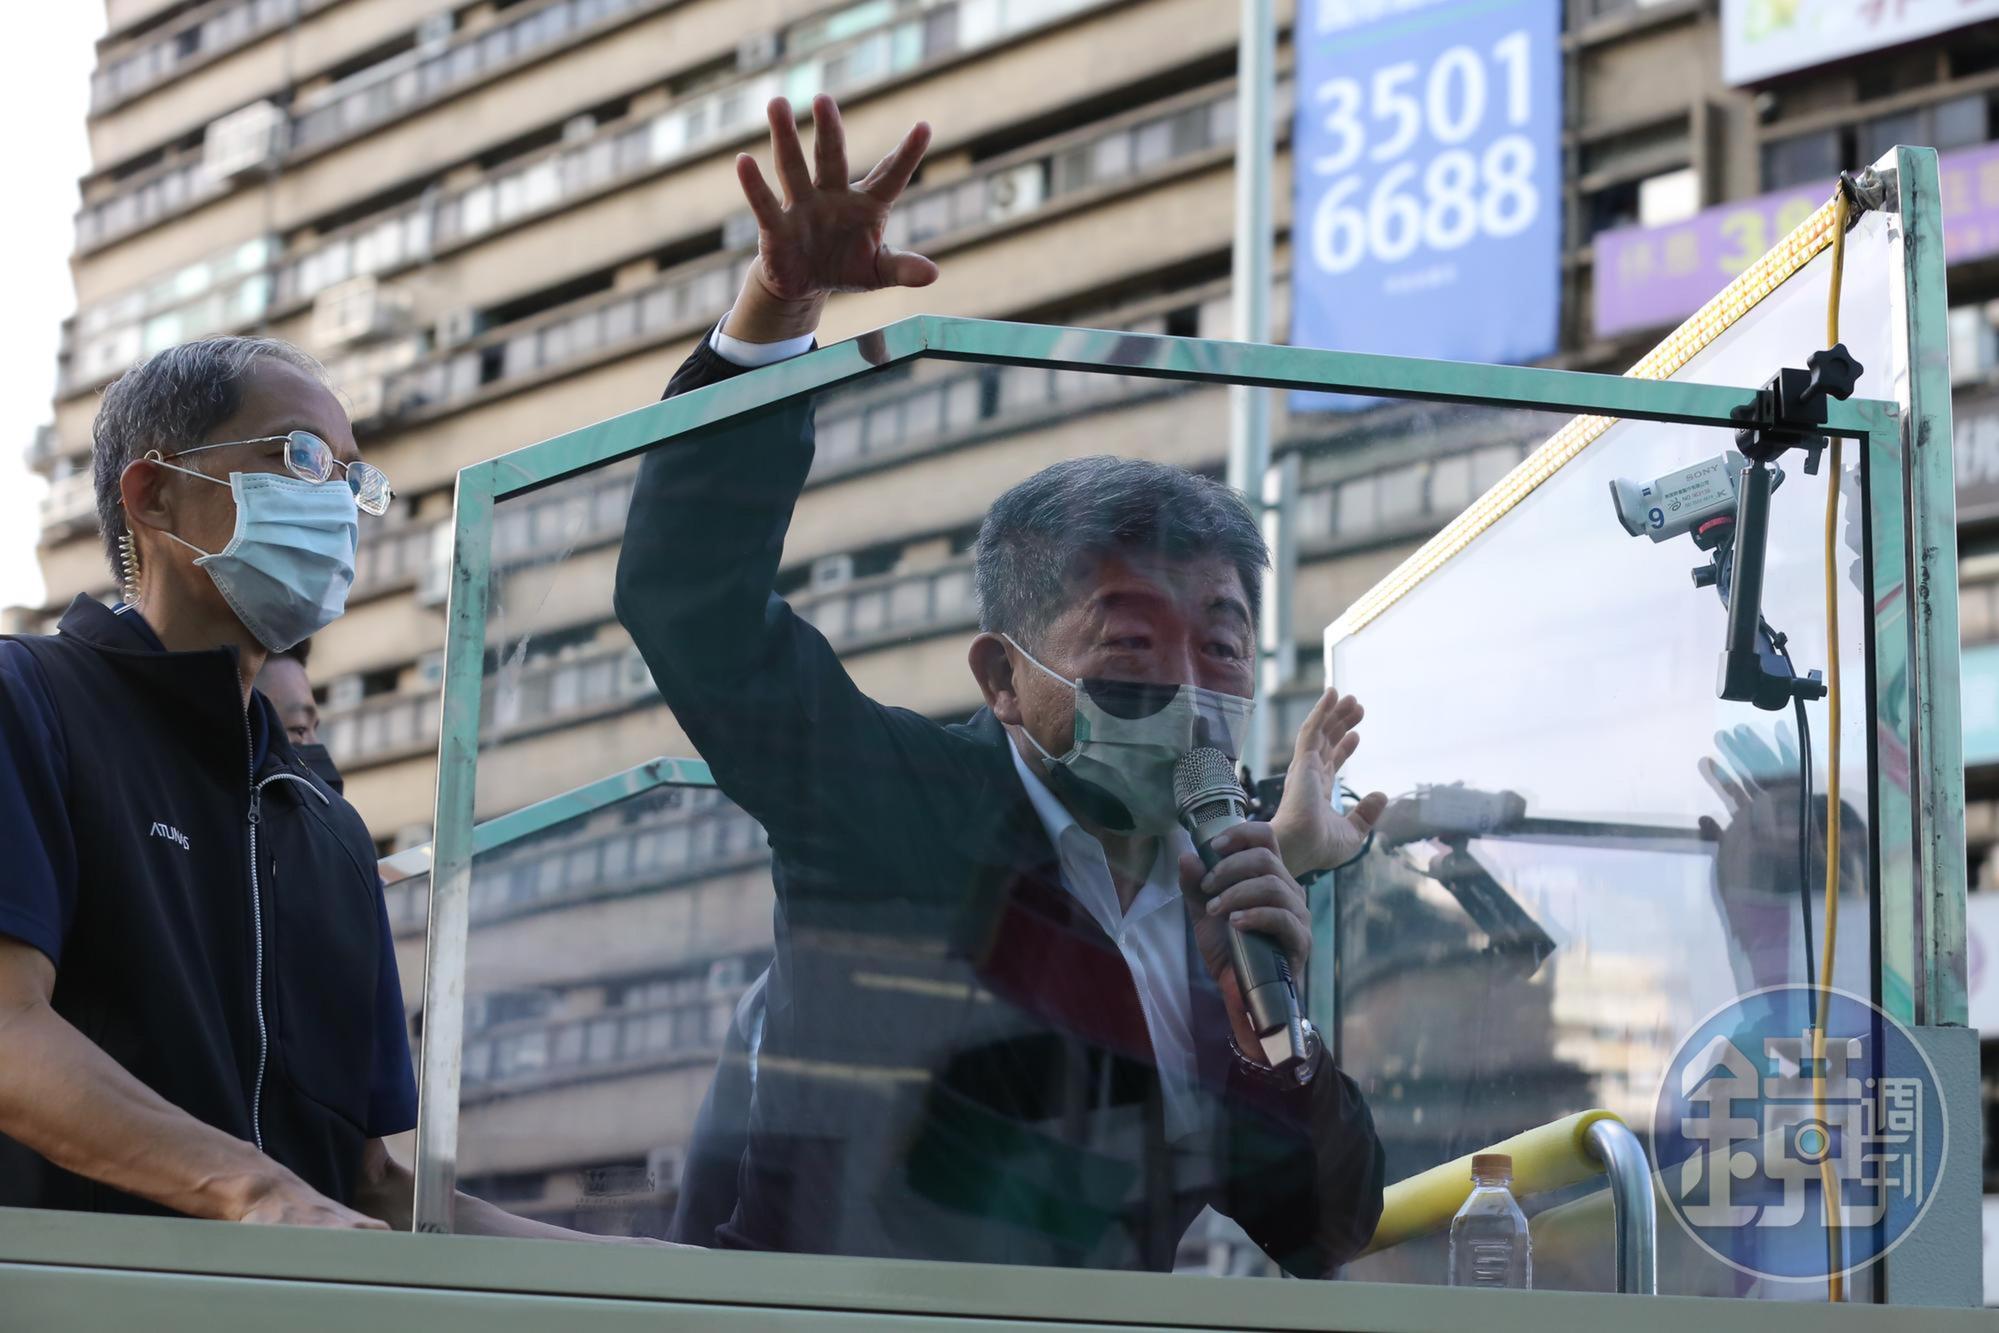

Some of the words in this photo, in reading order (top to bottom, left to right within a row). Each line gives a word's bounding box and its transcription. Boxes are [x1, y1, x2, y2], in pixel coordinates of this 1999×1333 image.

[1312, 28, 1532, 176] 3501
[1311, 132, 1540, 276] 6688
[1686, 463, 1719, 481] SONY
[1648, 507, 1665, 529] 9
